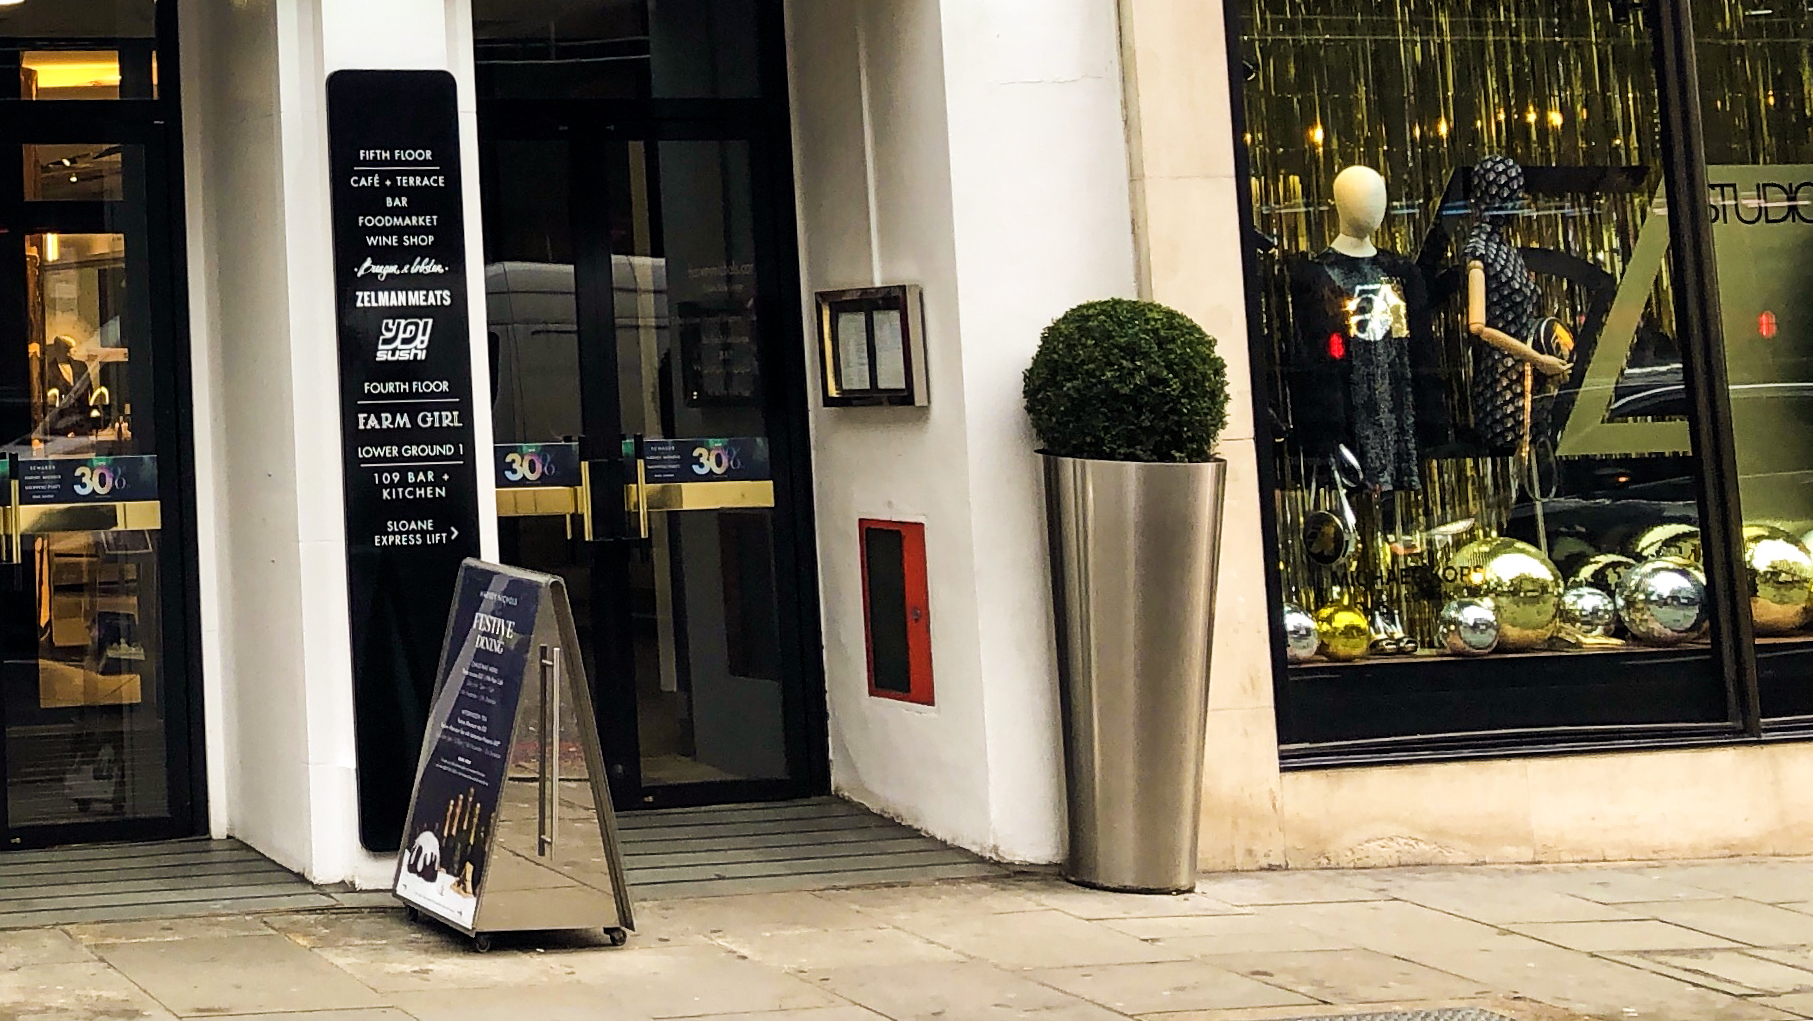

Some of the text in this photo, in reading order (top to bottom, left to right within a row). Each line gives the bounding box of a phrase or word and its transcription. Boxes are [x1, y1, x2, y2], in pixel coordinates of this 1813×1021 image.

[359, 149, 433, 161] FIFTH FLOOR
[350, 173, 380, 187] CAFÉ
[396, 175, 445, 187] TERRACE
[386, 196, 408, 208] BAR
[358, 215, 438, 227] FOODMARKET
[366, 235, 435, 247] WINE SHOP
[364, 381, 449, 394] FOURTH FLOOR
[358, 411, 463, 429] FARM GIRL
[358, 444, 464, 458] LOWER GROUND 1
[373, 472, 400, 484] 109
[408, 471, 434, 483] BAR
[382, 487, 446, 500] KITCHEN
[387, 520, 434, 531] SLOANE
[375, 533, 448, 546] EXPRESS LIFT
[473, 612, 515, 639] FESTIVE
